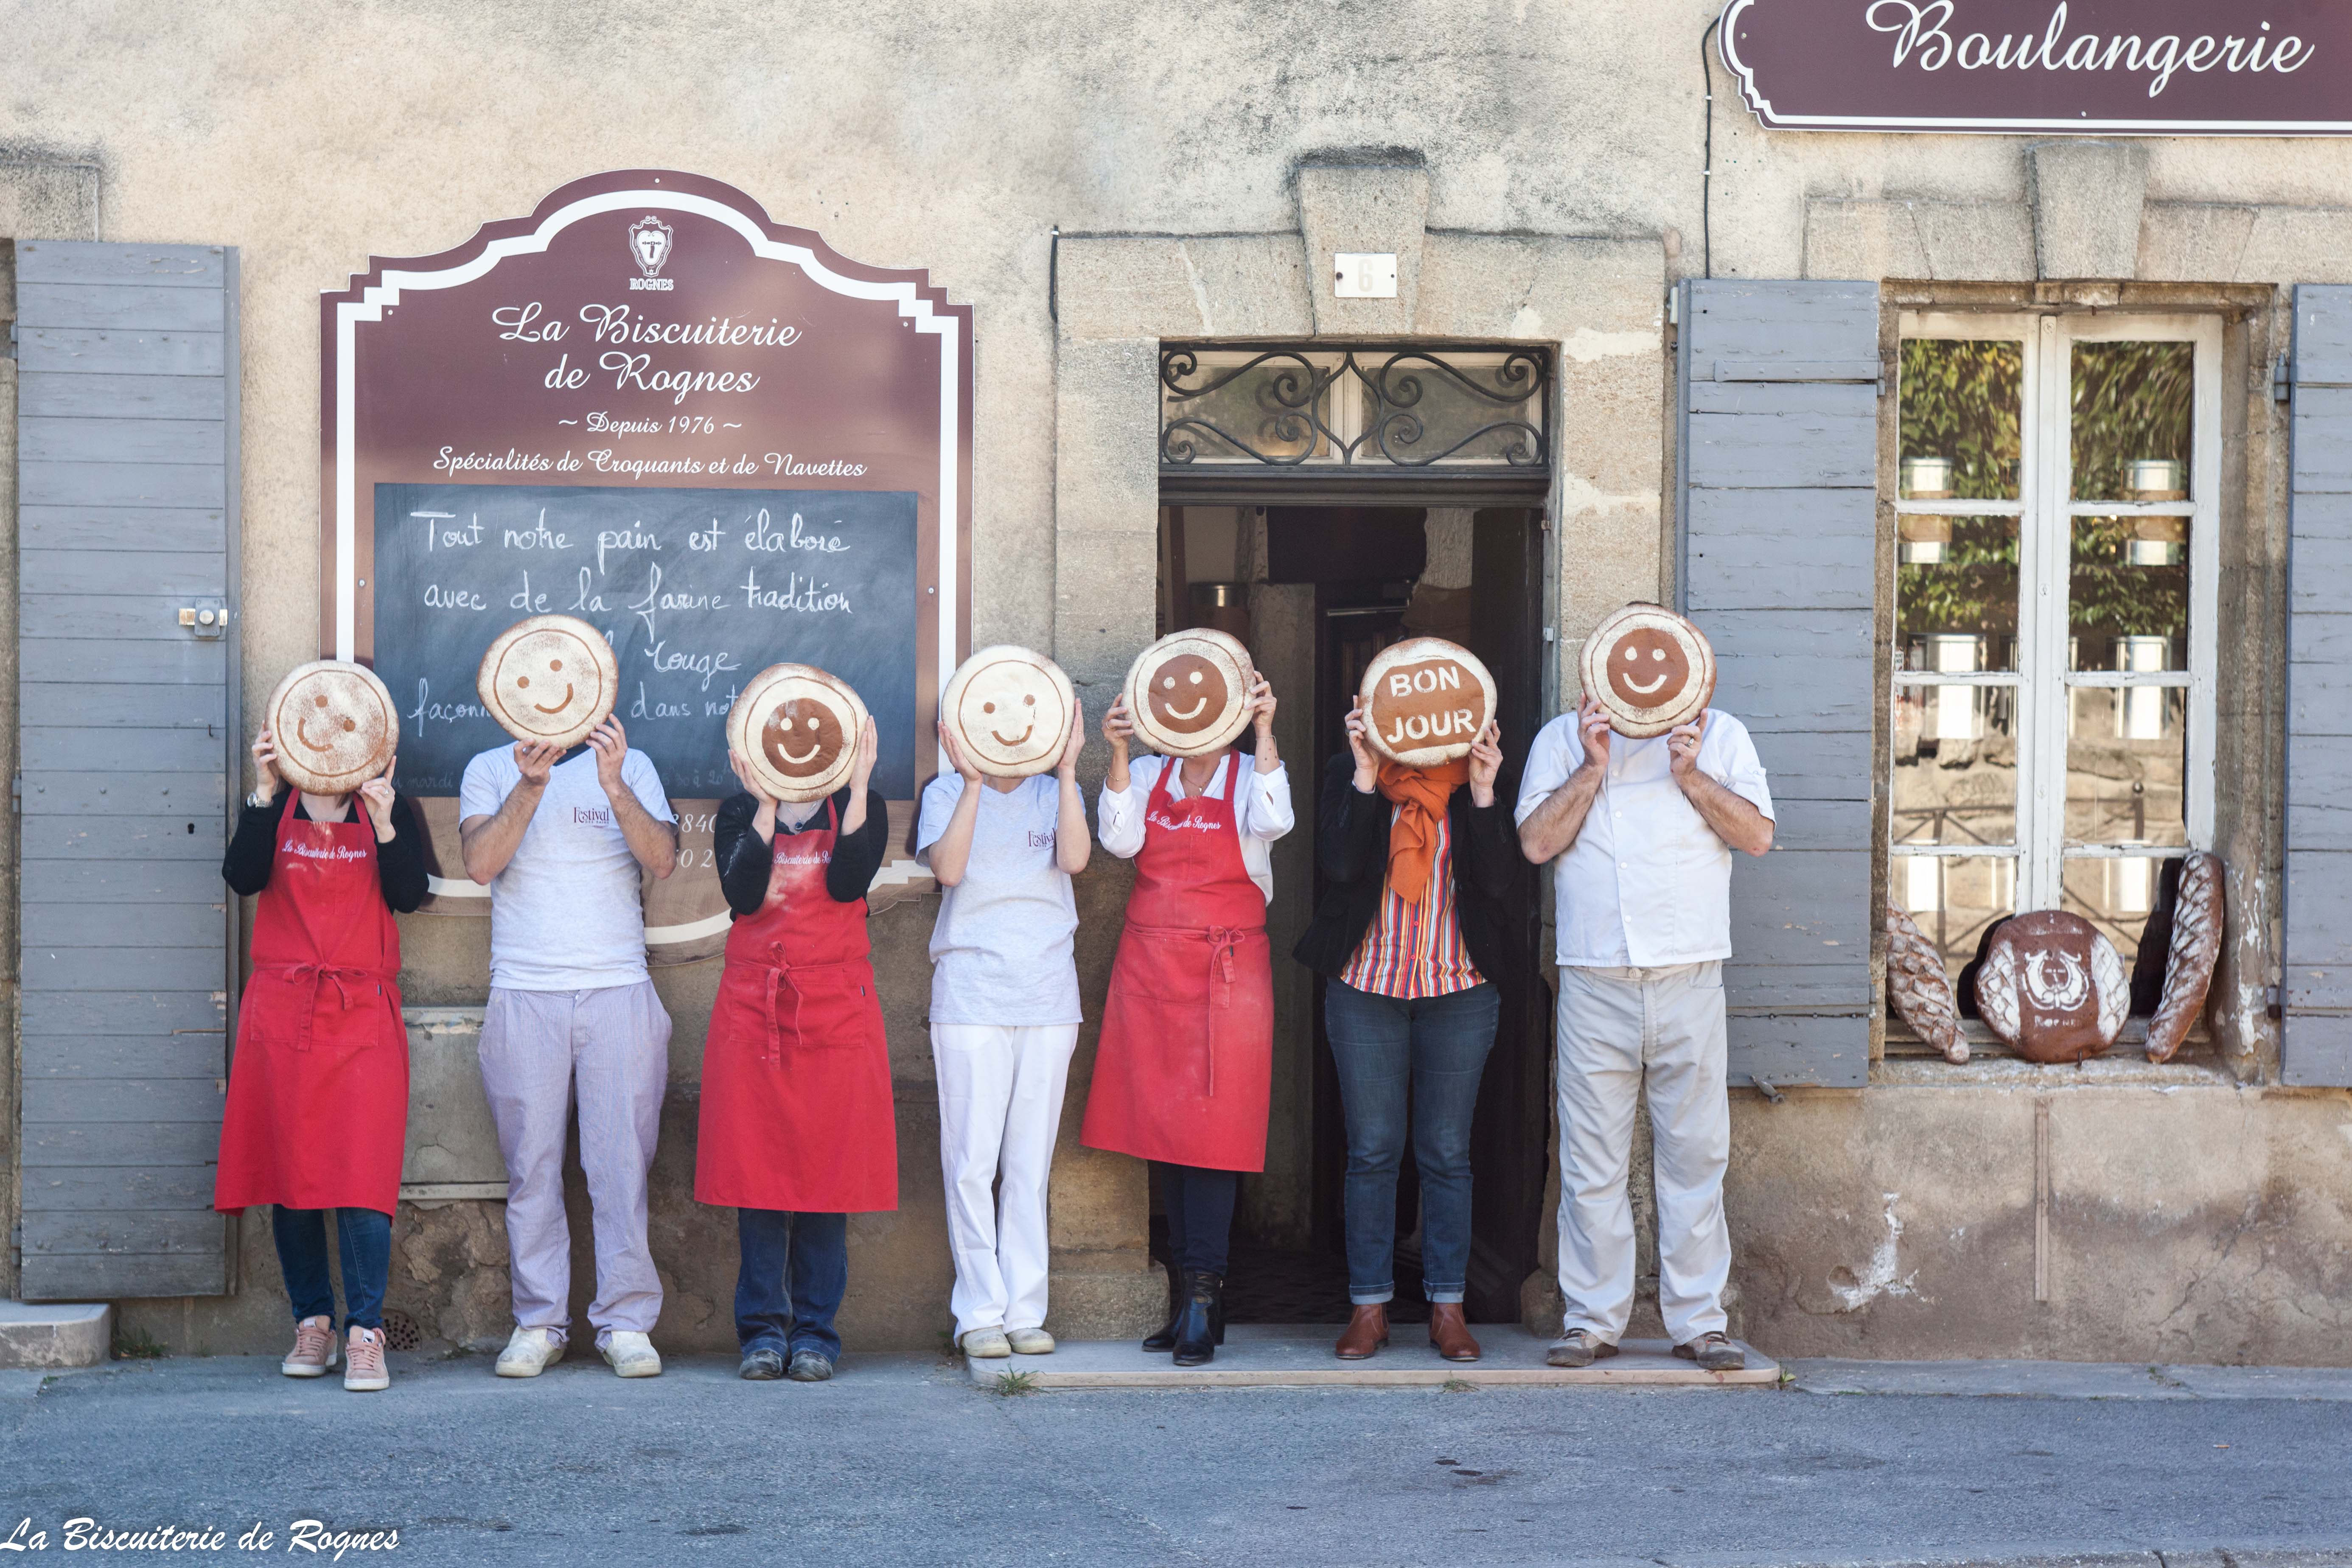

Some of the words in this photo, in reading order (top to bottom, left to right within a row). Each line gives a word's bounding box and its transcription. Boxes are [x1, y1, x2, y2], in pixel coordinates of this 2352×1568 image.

[1866, 0, 2315, 98] Boulangerie
[629, 278, 674, 291] ROGNES
[1358, 258, 1373, 292] 6
[492, 302, 570, 343] La
[580, 304, 803, 346] Biscuiterie
[544, 353, 591, 389] de
[599, 351, 760, 405] Rognes
[587, 411, 662, 440] Depuis
[669, 416, 715, 434] 1976
[433, 446, 553, 477] Spécialités
[557, 450, 583, 472] de
[588, 449, 705, 480] Croquants
[708, 457, 729, 474] et
[732, 454, 759, 475] de
[764, 453, 868, 477] Navettes
[410, 511, 485, 552] Tout
[504, 507, 574, 549] notre
[598, 520, 662, 575] pain
[689, 517, 726, 551] est
[744, 508, 851, 552] élaboré
[424, 584, 486, 610] avec
[510, 569, 552, 613] de
[568, 566, 612, 612] la
[628, 561, 732, 644] farine
[739, 566, 853, 613] tradition
[1389, 666, 1461, 697] BON
[407, 677, 491, 738] façonn
[631, 680, 691, 720] dans
[704, 684, 739, 718] not
[1386, 708, 1477, 744] JOUR
[573, 806, 609, 823] Festival
[1147, 810, 1159, 822] La
[1183, 814, 1192, 828] de
[1192, 815, 1222, 833] Rognes
[282, 839, 294, 852] La
[336, 845, 367, 863] Rognes
[774, 851, 813, 865] Biscuiterie
[813, 850, 821, 865] de
